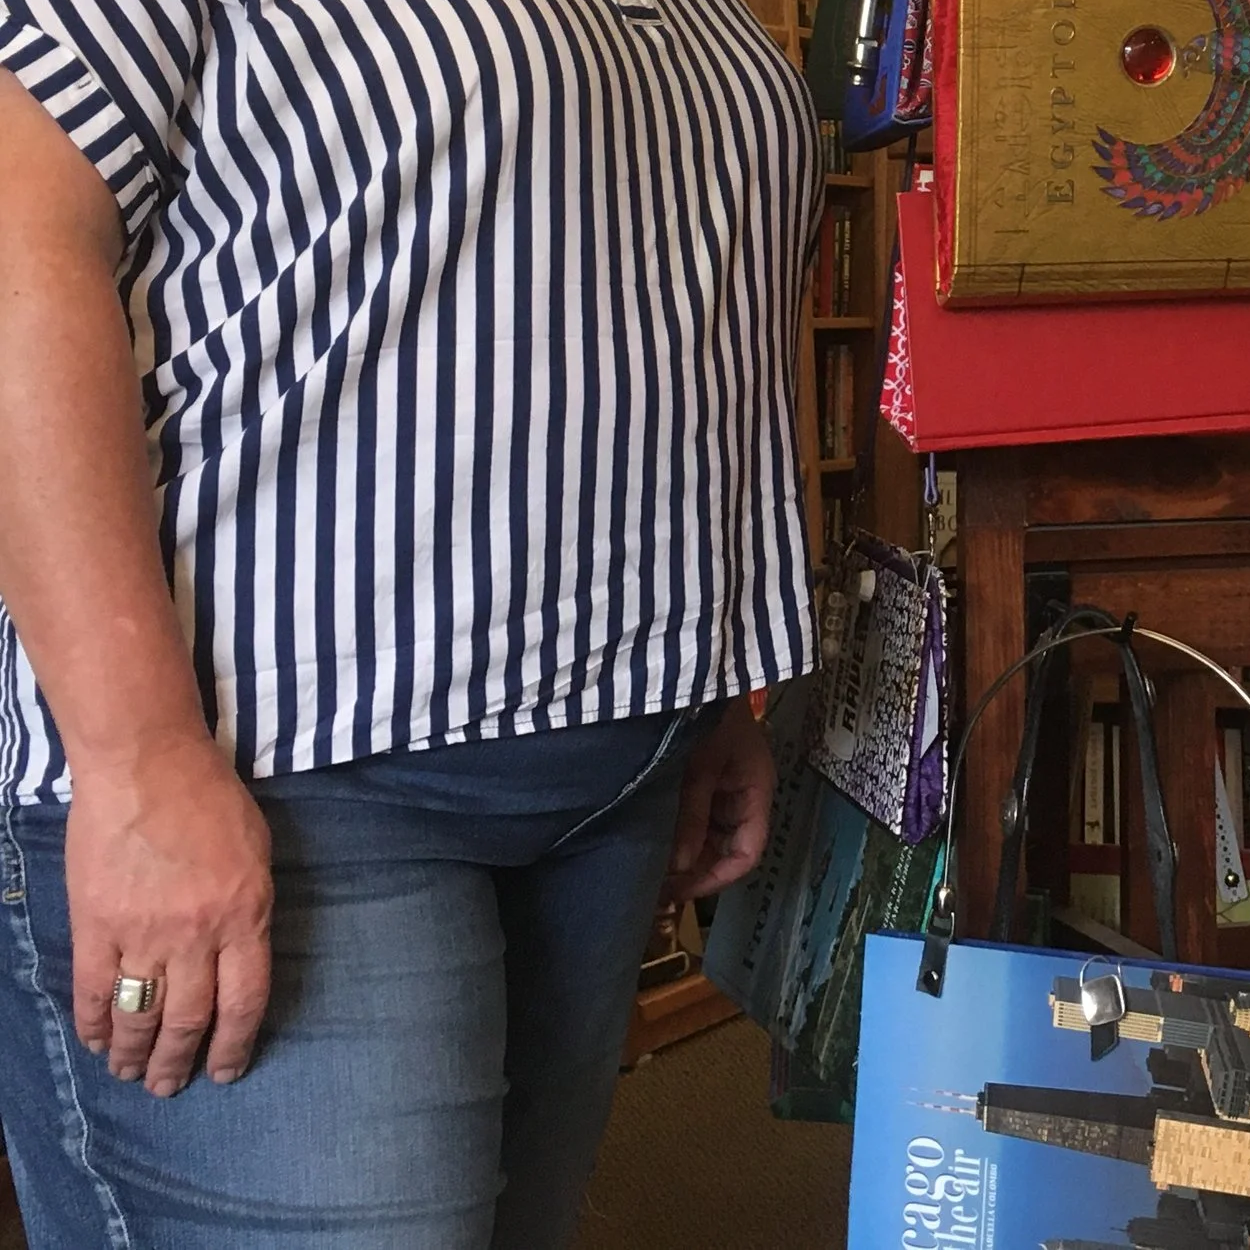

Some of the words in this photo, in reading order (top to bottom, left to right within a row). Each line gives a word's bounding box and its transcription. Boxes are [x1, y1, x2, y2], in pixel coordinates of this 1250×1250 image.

[948, 1147, 981, 1195] air
[987, 1162, 998, 1207] COLOMBO
[986, 1208, 996, 1249] ARCELLA
